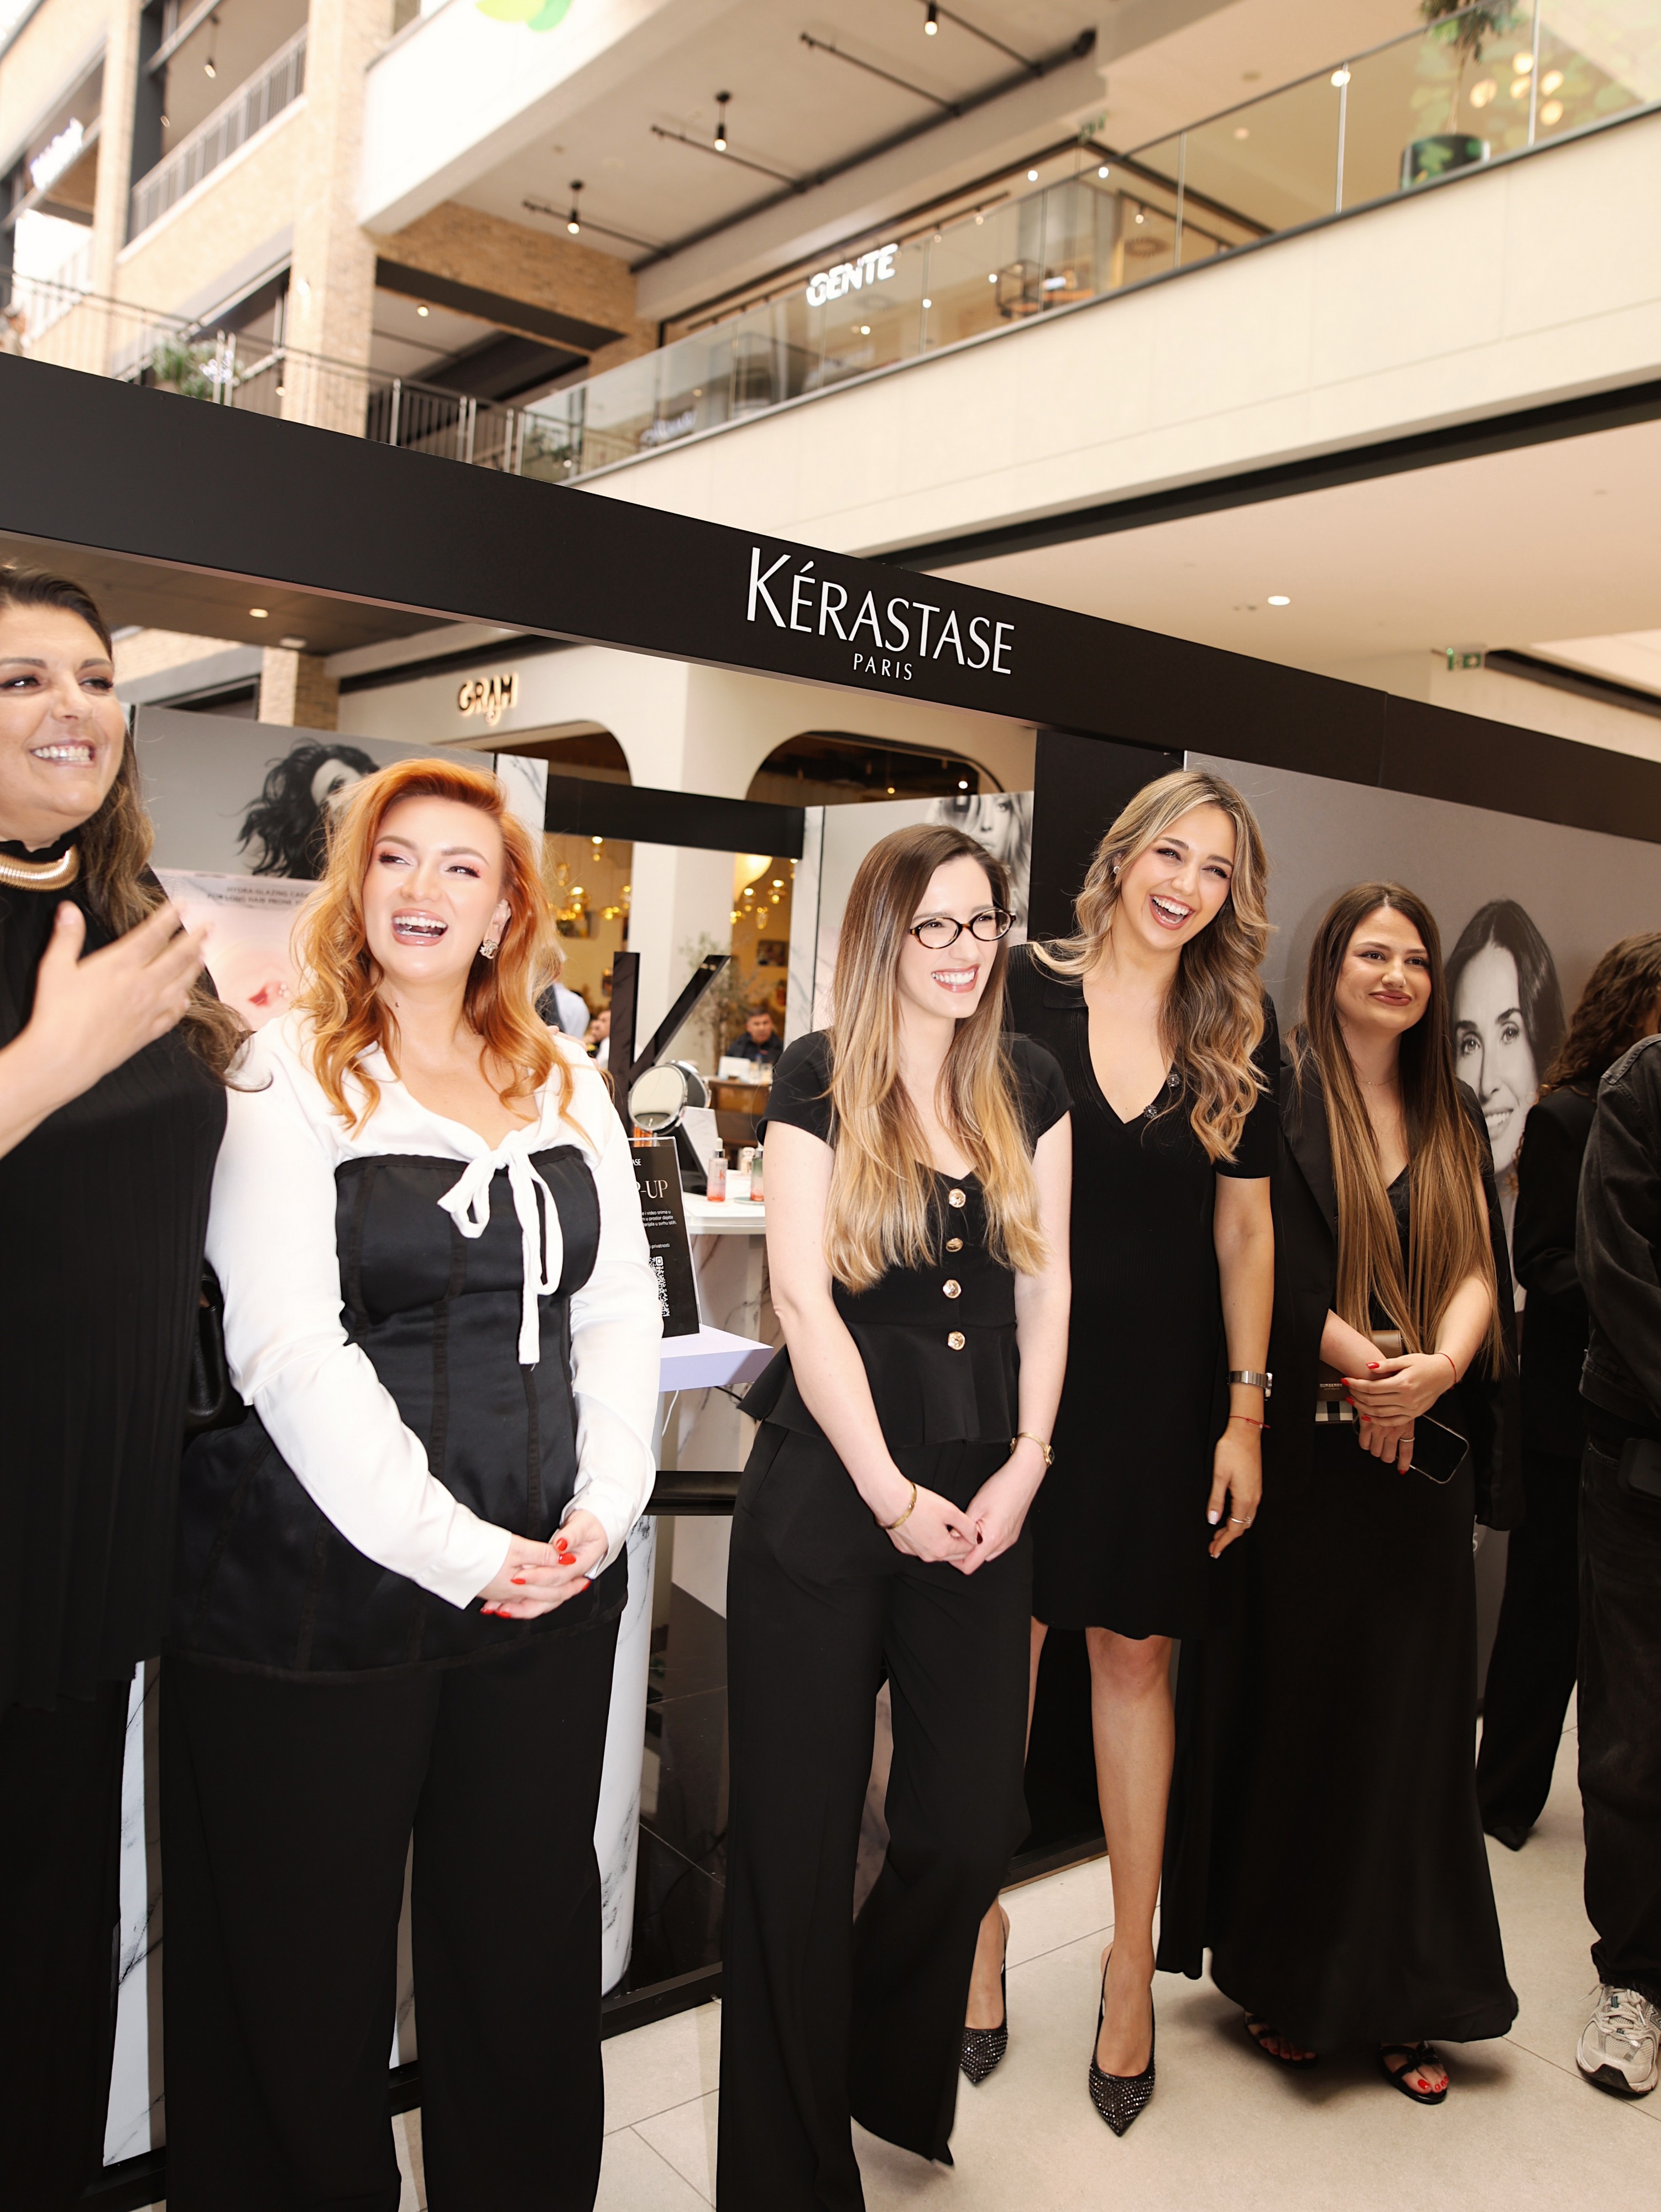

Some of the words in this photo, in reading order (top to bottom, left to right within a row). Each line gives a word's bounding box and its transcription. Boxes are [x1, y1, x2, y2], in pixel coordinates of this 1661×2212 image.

[806, 243, 899, 306] GENTE
[747, 547, 1015, 675] KÉRASTASE
[853, 653, 912, 681] PARIS
